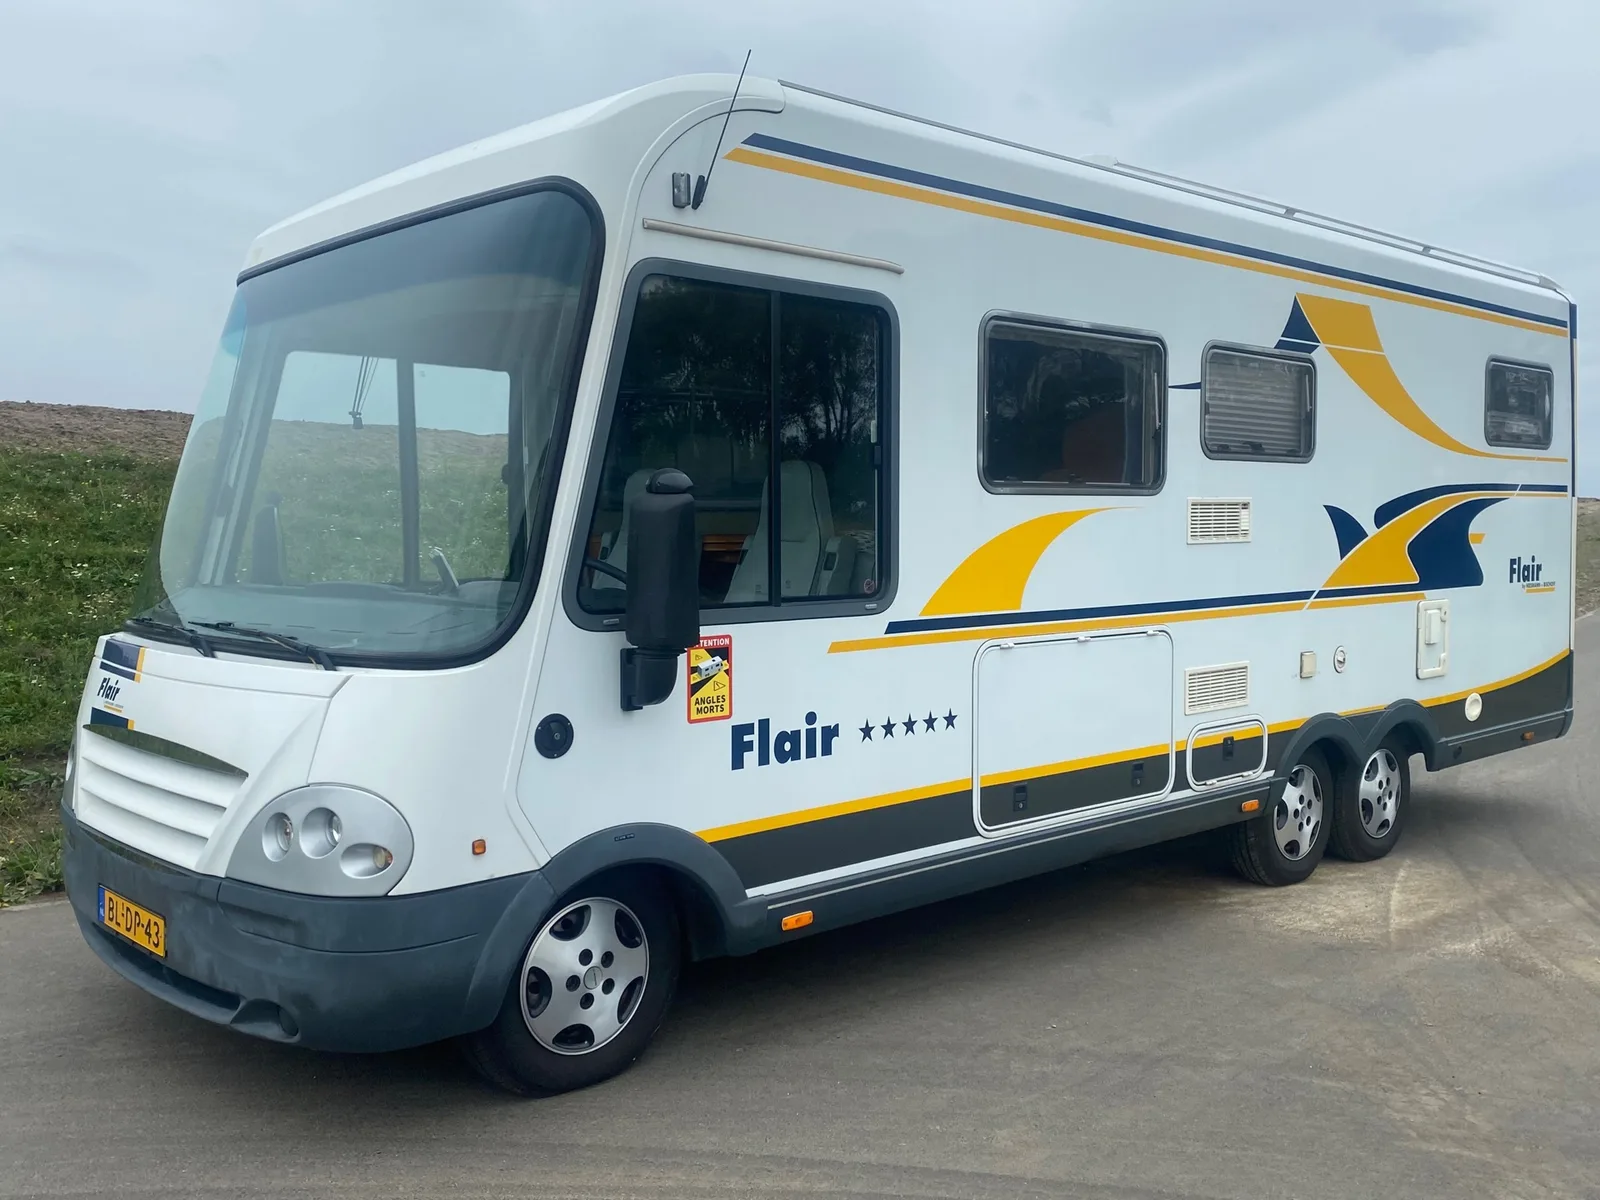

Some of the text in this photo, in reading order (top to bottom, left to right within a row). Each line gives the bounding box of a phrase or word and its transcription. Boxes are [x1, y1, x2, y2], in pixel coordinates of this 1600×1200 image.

[1509, 555, 1542, 583] Flair
[694, 638, 730, 648] TENTION
[97, 677, 120, 701] Flair
[694, 695, 726, 706] ANGLES
[696, 704, 725, 715] MORTS
[731, 711, 839, 771] Flair
[108, 896, 160, 948] BL-DP-43
